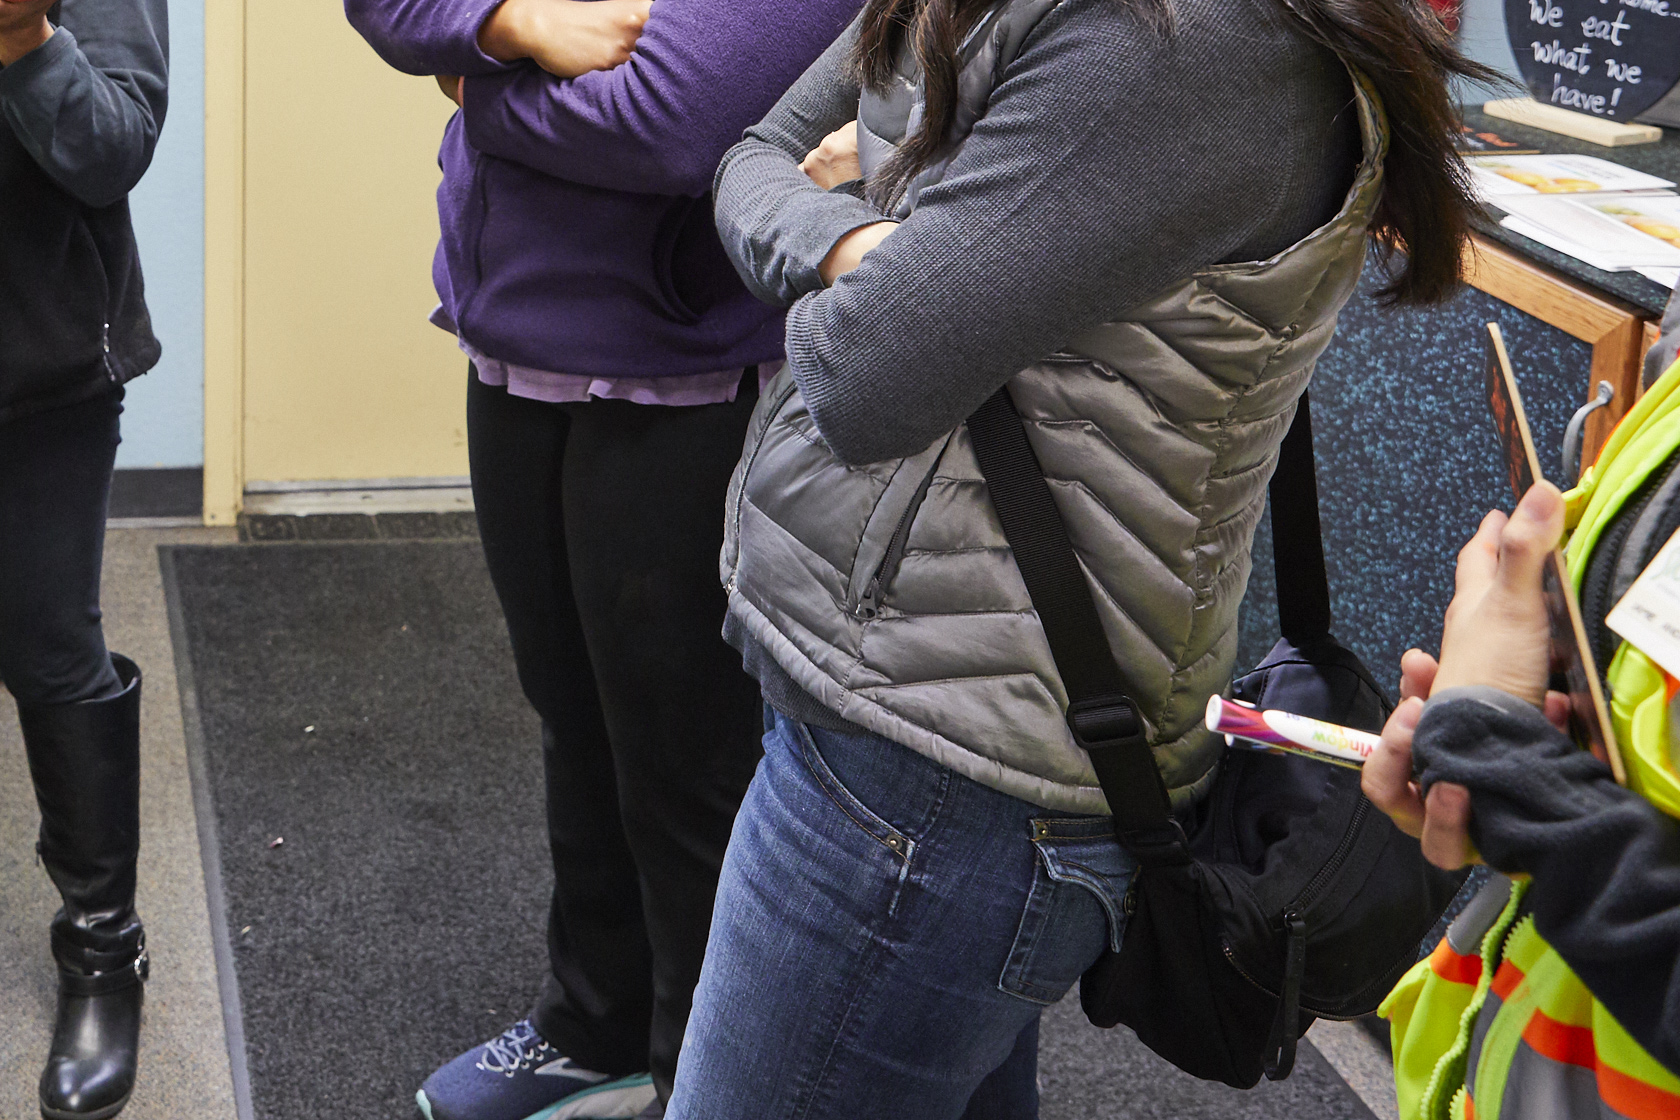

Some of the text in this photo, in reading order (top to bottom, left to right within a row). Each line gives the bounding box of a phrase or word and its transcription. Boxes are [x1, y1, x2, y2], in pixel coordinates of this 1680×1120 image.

[1581, 9, 1631, 46] eat
[1531, 39, 1642, 84] what we
[1551, 72, 1622, 115] have!
